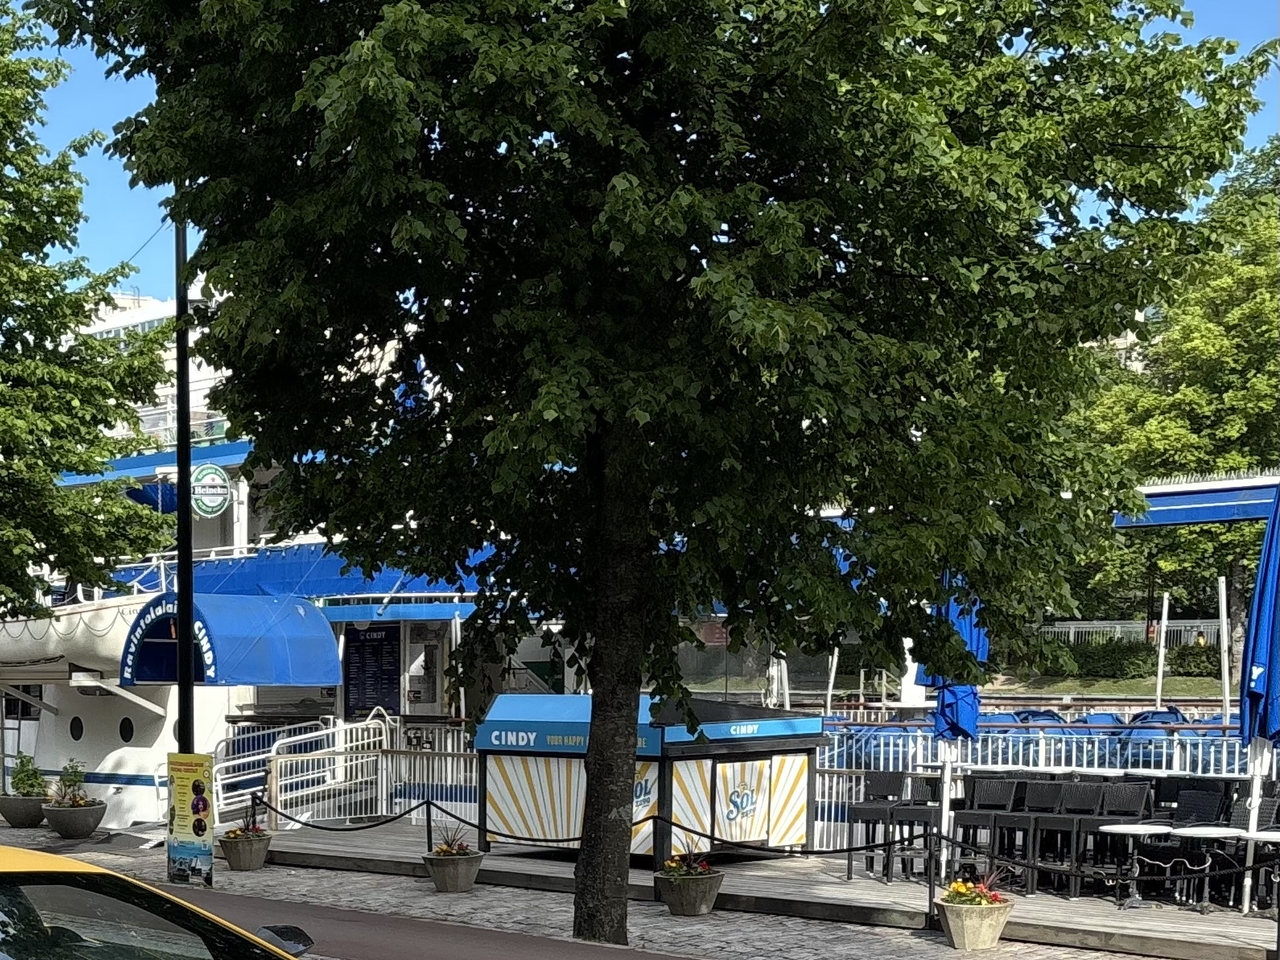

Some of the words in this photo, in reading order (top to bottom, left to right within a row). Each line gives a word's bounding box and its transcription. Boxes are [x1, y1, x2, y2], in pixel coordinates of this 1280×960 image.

[123, 600, 179, 679] Ravintolalai
[193, 620, 216, 679] CINDY
[365, 631, 386, 640] CINDY
[729, 724, 760, 735] CINDY
[490, 730, 538, 747] CINDY
[634, 778, 653, 799] OL
